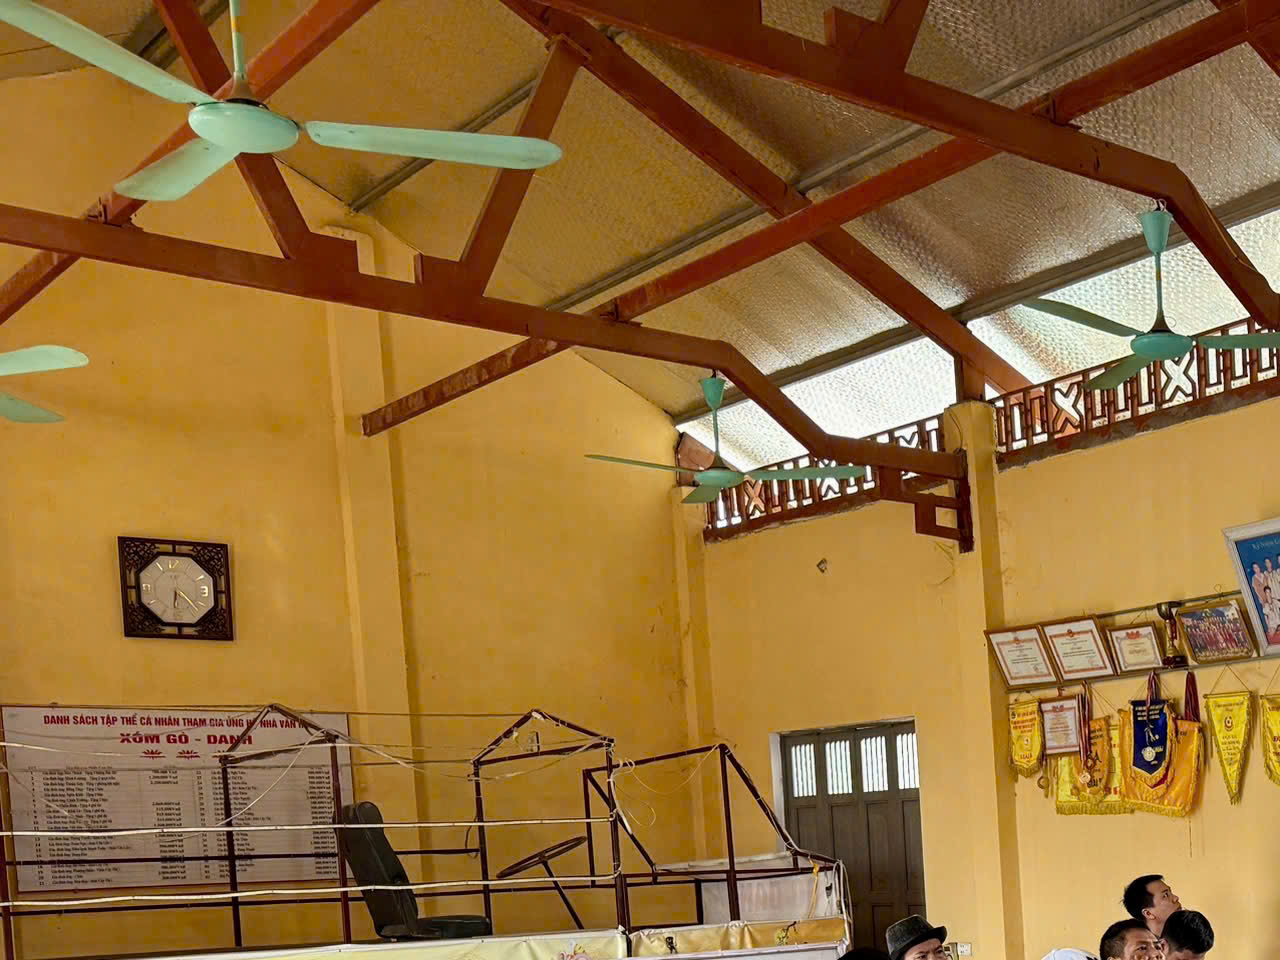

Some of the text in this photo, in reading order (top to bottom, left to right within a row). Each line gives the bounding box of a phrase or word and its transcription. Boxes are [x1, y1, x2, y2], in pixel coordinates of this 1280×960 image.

[43, 714, 70, 725] DANH
[72, 713, 98, 725] SÁCH
[100, 713, 118, 728] TẬP
[120, 712, 138, 726] THỂ
[154, 715, 180, 727] NHÂN
[209, 718, 225, 728] GIA
[120, 731, 160, 744] XÓM
[206, 734, 253, 745] DANH
